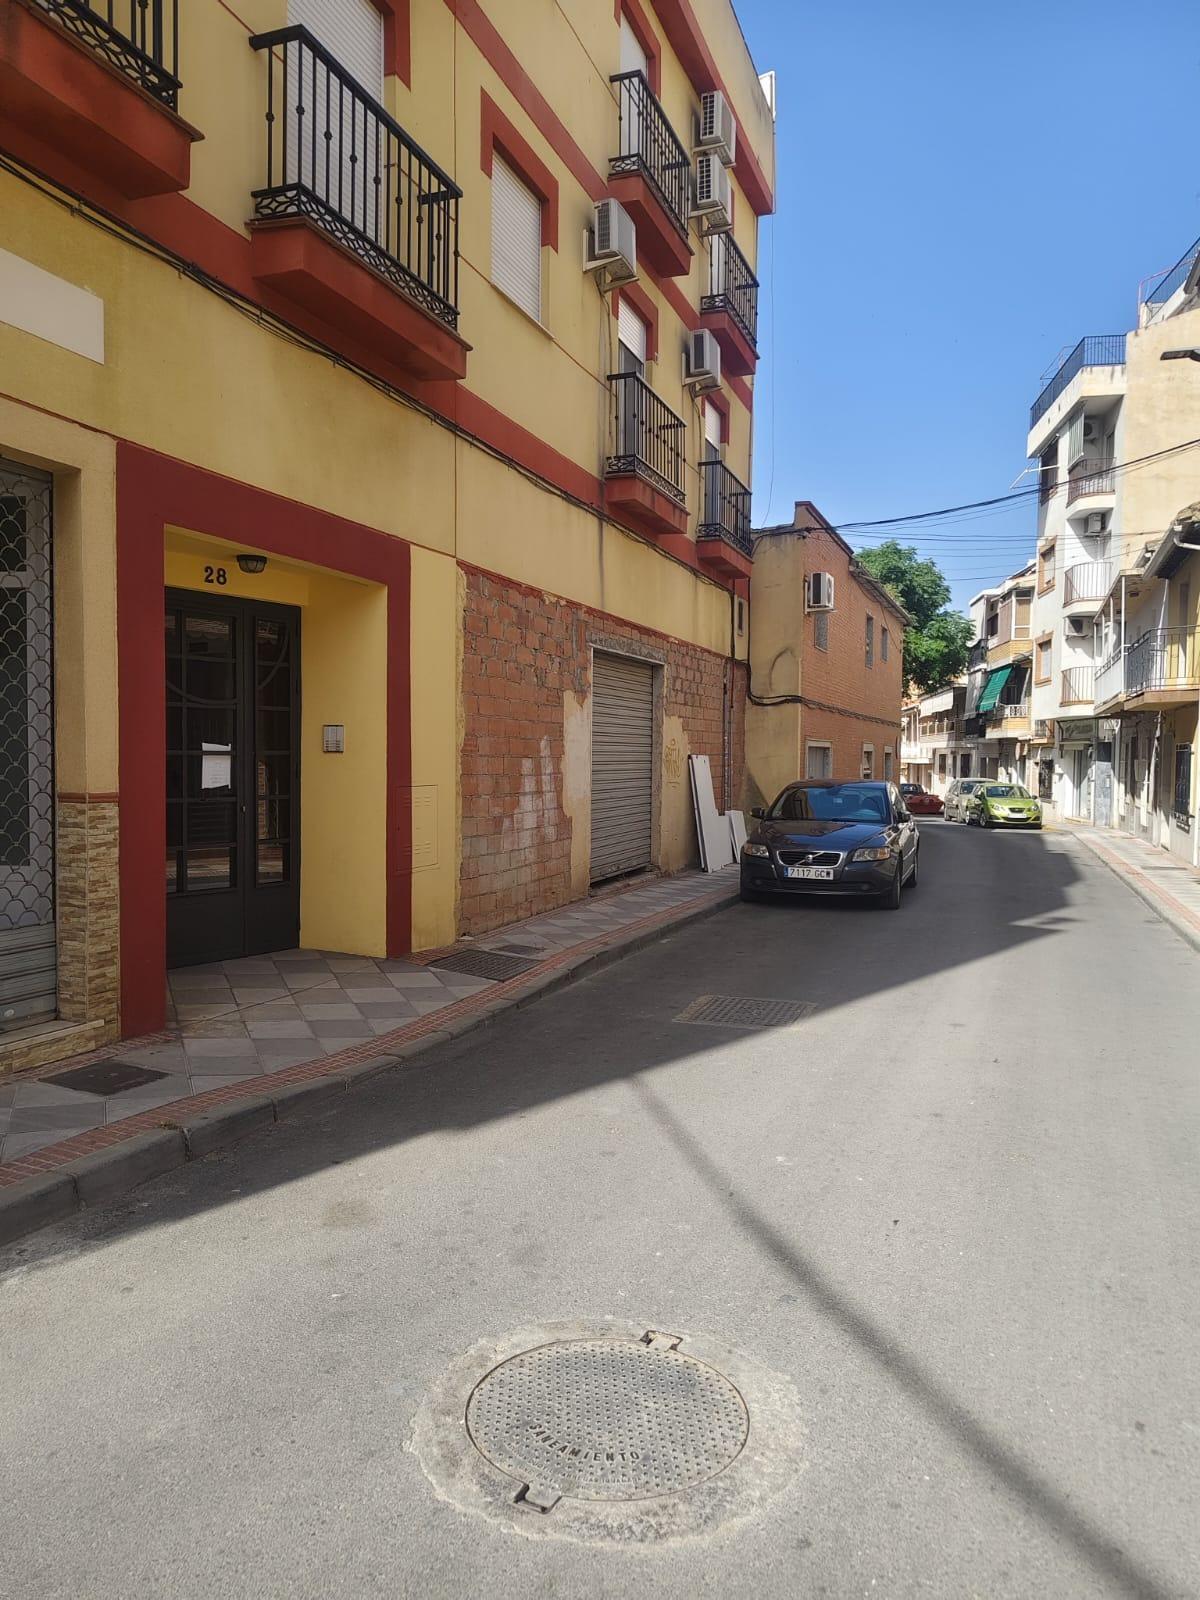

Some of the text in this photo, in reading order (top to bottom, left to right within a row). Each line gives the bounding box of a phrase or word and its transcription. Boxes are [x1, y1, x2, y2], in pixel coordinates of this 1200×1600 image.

[204, 565, 228, 585] 28
[790, 868, 811, 878] 7117
[529, 1423, 640, 1462] SANEAMIENTO
